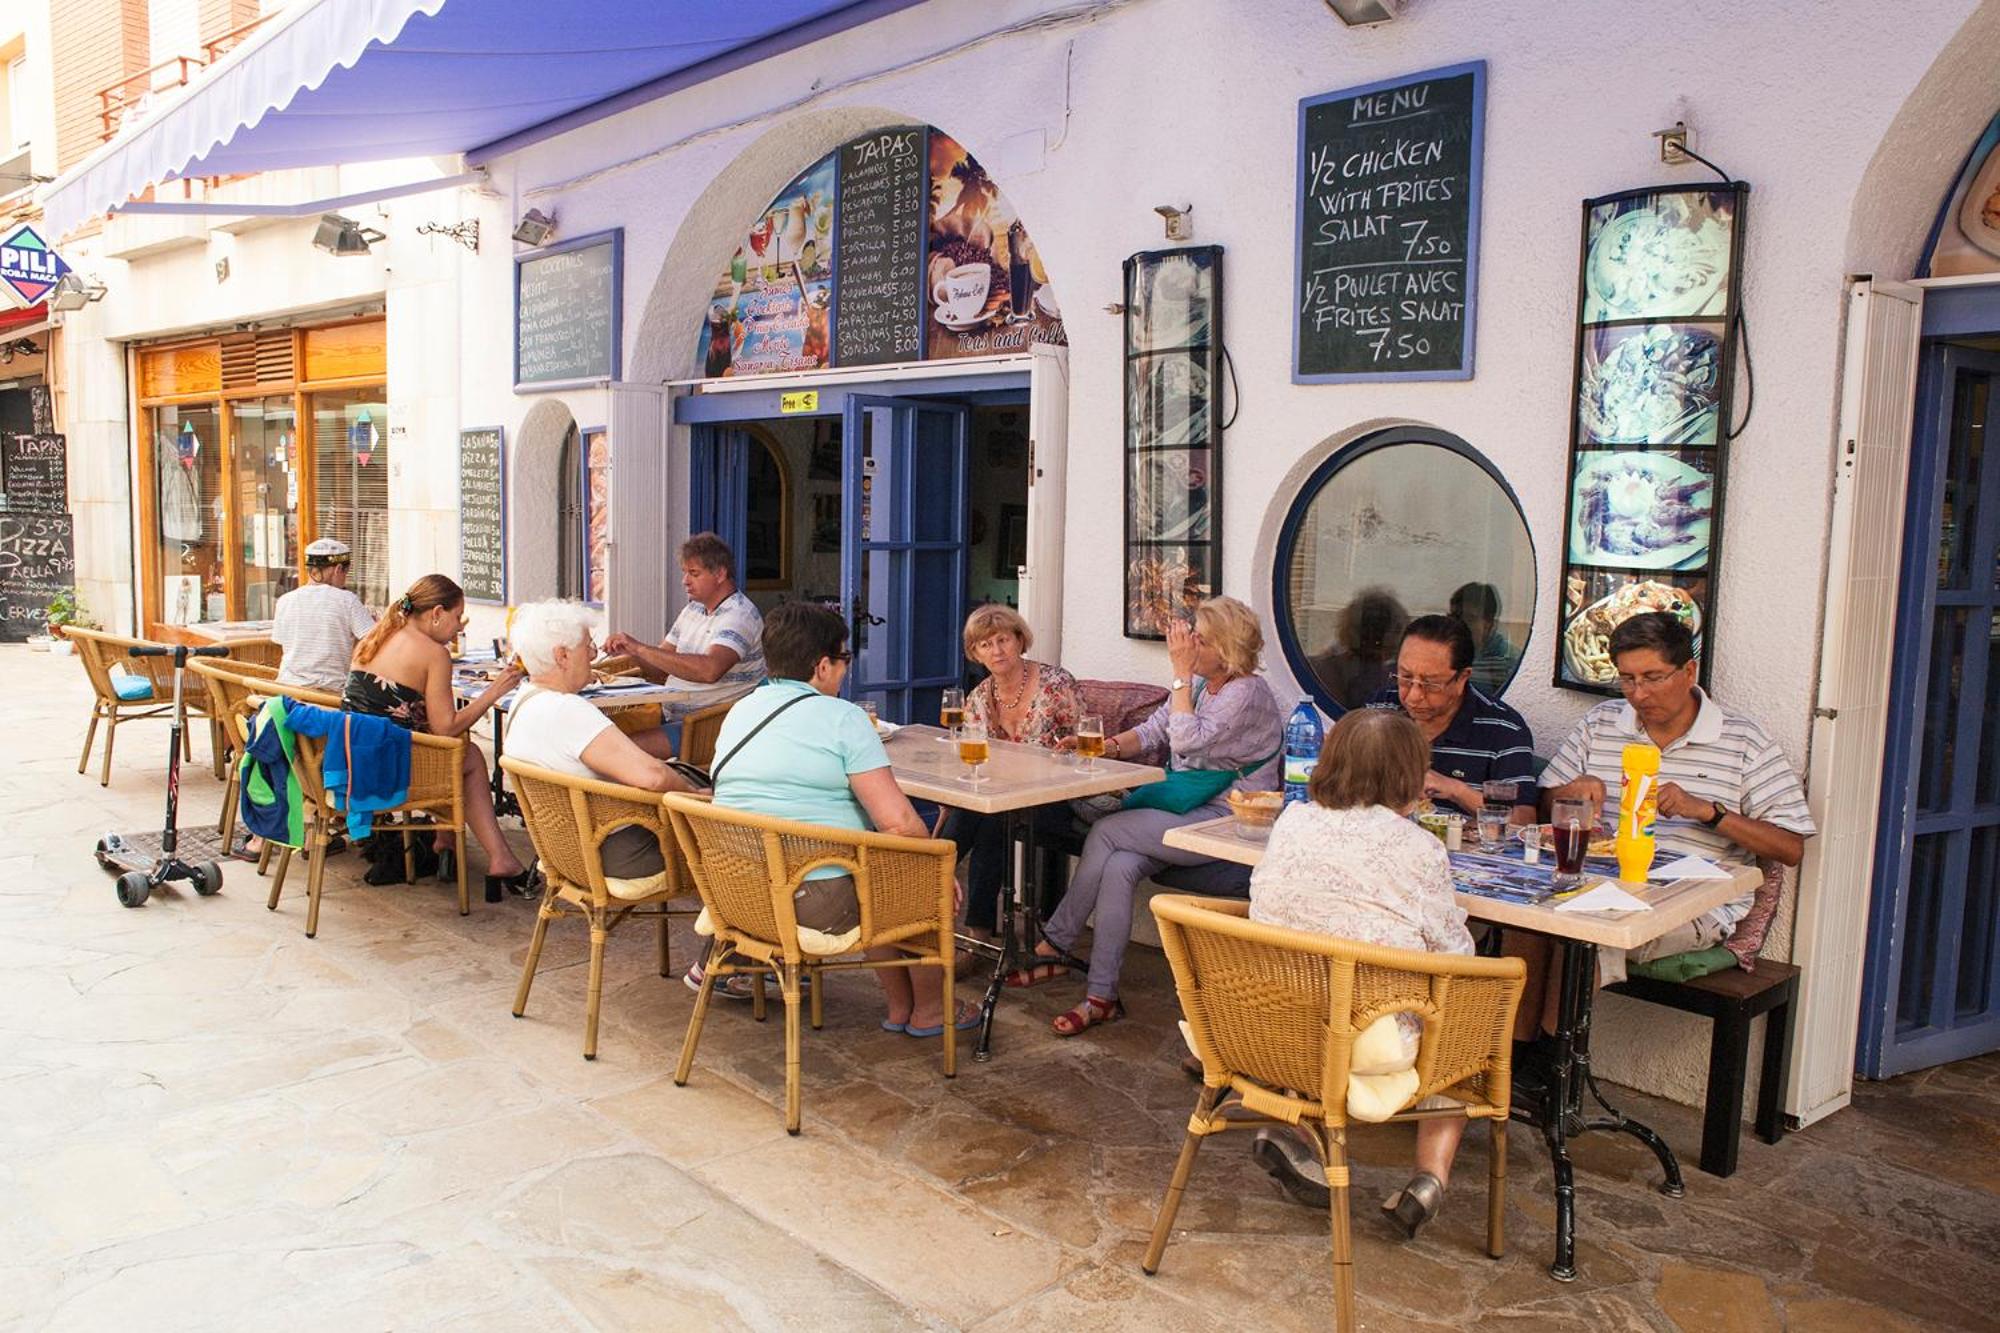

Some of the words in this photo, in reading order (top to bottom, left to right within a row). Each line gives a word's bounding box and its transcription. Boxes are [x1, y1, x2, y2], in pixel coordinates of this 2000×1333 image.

[1352, 85, 1429, 121] MENU
[853, 132, 918, 165] TAPAS
[894, 154, 918, 171] 5.00
[1310, 145, 1335, 197] 1/2
[1342, 139, 1443, 178] CHICKEN
[894, 172, 918, 185] 5.00
[894, 186, 918, 202] 5.00
[1319, 187, 1371, 215] WITH
[1376, 174, 1455, 207] FRITES
[893, 200, 918, 215] 5.50
[893, 220, 916, 232] 5.00
[1312, 215, 1393, 246] SALAT
[892, 232, 916, 248] 5.00
[1, 247, 56, 274] PILI
[891, 250, 916, 263] 6.00
[890, 266, 915, 278] 6.00
[891, 282, 914, 294] 5.00
[1302, 276, 1329, 313] 1/2
[1334, 271, 1403, 304] POULET
[1404, 271, 1458, 294] AVEC
[841, 300, 877, 313] BRAVAS
[892, 308, 916, 320] 4.50
[1314, 302, 1391, 332] FRITES
[1401, 301, 1464, 322] SALAT
[894, 325, 918, 338] 5.00
[959, 332, 988, 352] Teas
[994, 328, 1024, 348] and
[841, 341, 880, 358] SONSOS
[895, 339, 919, 353] 5.00
[1356, 327, 1430, 361] 7.50
[14, 435, 64, 454] TAPAS
